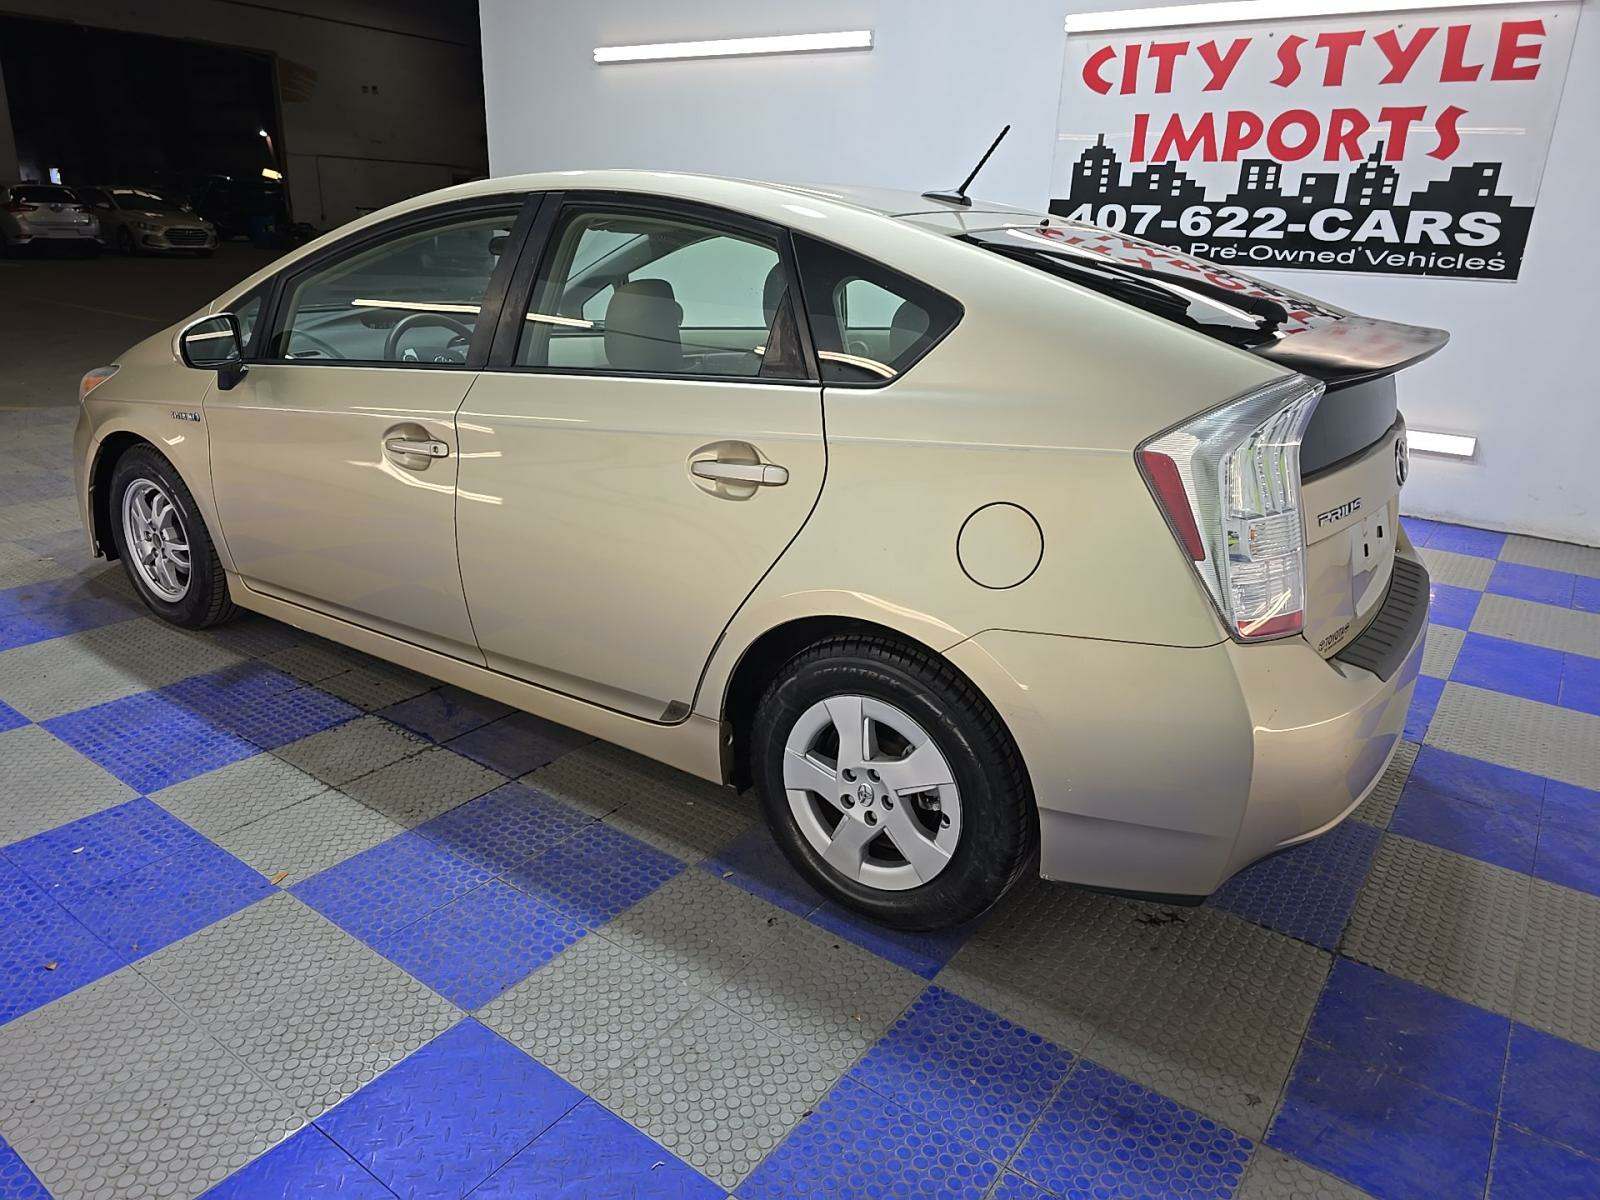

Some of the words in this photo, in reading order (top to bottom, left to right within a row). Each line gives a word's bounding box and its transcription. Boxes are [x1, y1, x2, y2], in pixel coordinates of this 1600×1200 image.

[1082, 38, 1252, 95] CITY
[1270, 19, 1547, 88] STYLE
[1129, 105, 1469, 163] IMPORTS
[1067, 202, 1502, 247] 407-622-CARS
[1189, 242, 1355, 264] Pre-Owned
[1363, 248, 1506, 272] Vehicles
[1317, 497, 1362, 528] PRIUS
